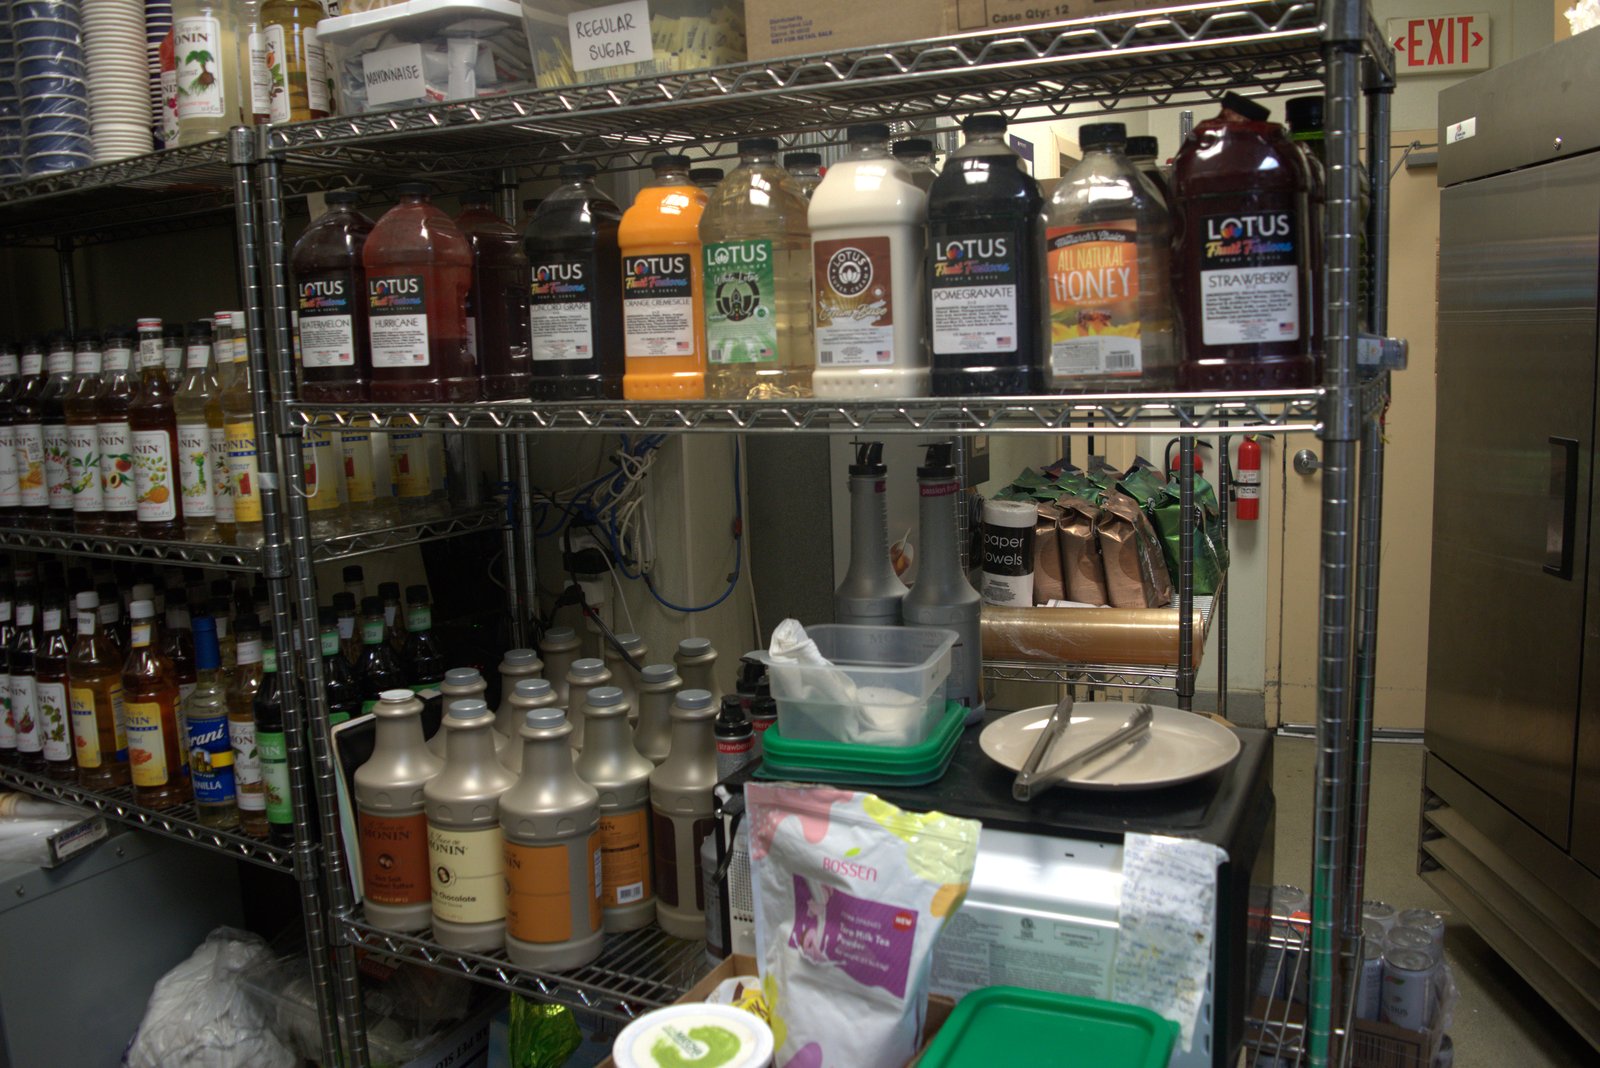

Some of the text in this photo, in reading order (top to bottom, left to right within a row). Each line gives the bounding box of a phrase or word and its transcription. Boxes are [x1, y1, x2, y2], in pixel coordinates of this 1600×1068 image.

[993, 5, 1069, 24] Case Qty: 12
[576, 13, 636, 38] REGULAR
[589, 40, 635, 61] SUGAR
[1408, 16, 1474, 66] EXIT
[366, 64, 420, 86] MAYONNAISE
[1208, 214, 1290, 240] LOTUS
[707, 243, 768, 266] LOTUS
[936, 238, 1007, 260] LOTUS
[1057, 245, 1124, 271] ALL NATURAL
[626, 256, 684, 276] LOTUS
[832, 251, 867, 267] LOTUS
[531, 264, 583, 282] LOTUS
[1208, 272, 1290, 288] STRAWBERRY
[299, 280, 344, 297] LOTUS
[370, 278, 418, 295] LOTUS
[933, 286, 1013, 301] POMEGRANATE
[1054, 267, 1130, 301] HONEY
[374, 318, 418, 329] HURRICANE
[985, 552, 1023, 566] owels
[187, 724, 225, 746] rani
[439, 891, 477, 903] Chocolate
[895, 916, 912, 926] NEW
[856, 928, 873, 943] Milk
[876, 933, 890, 947] Tea
